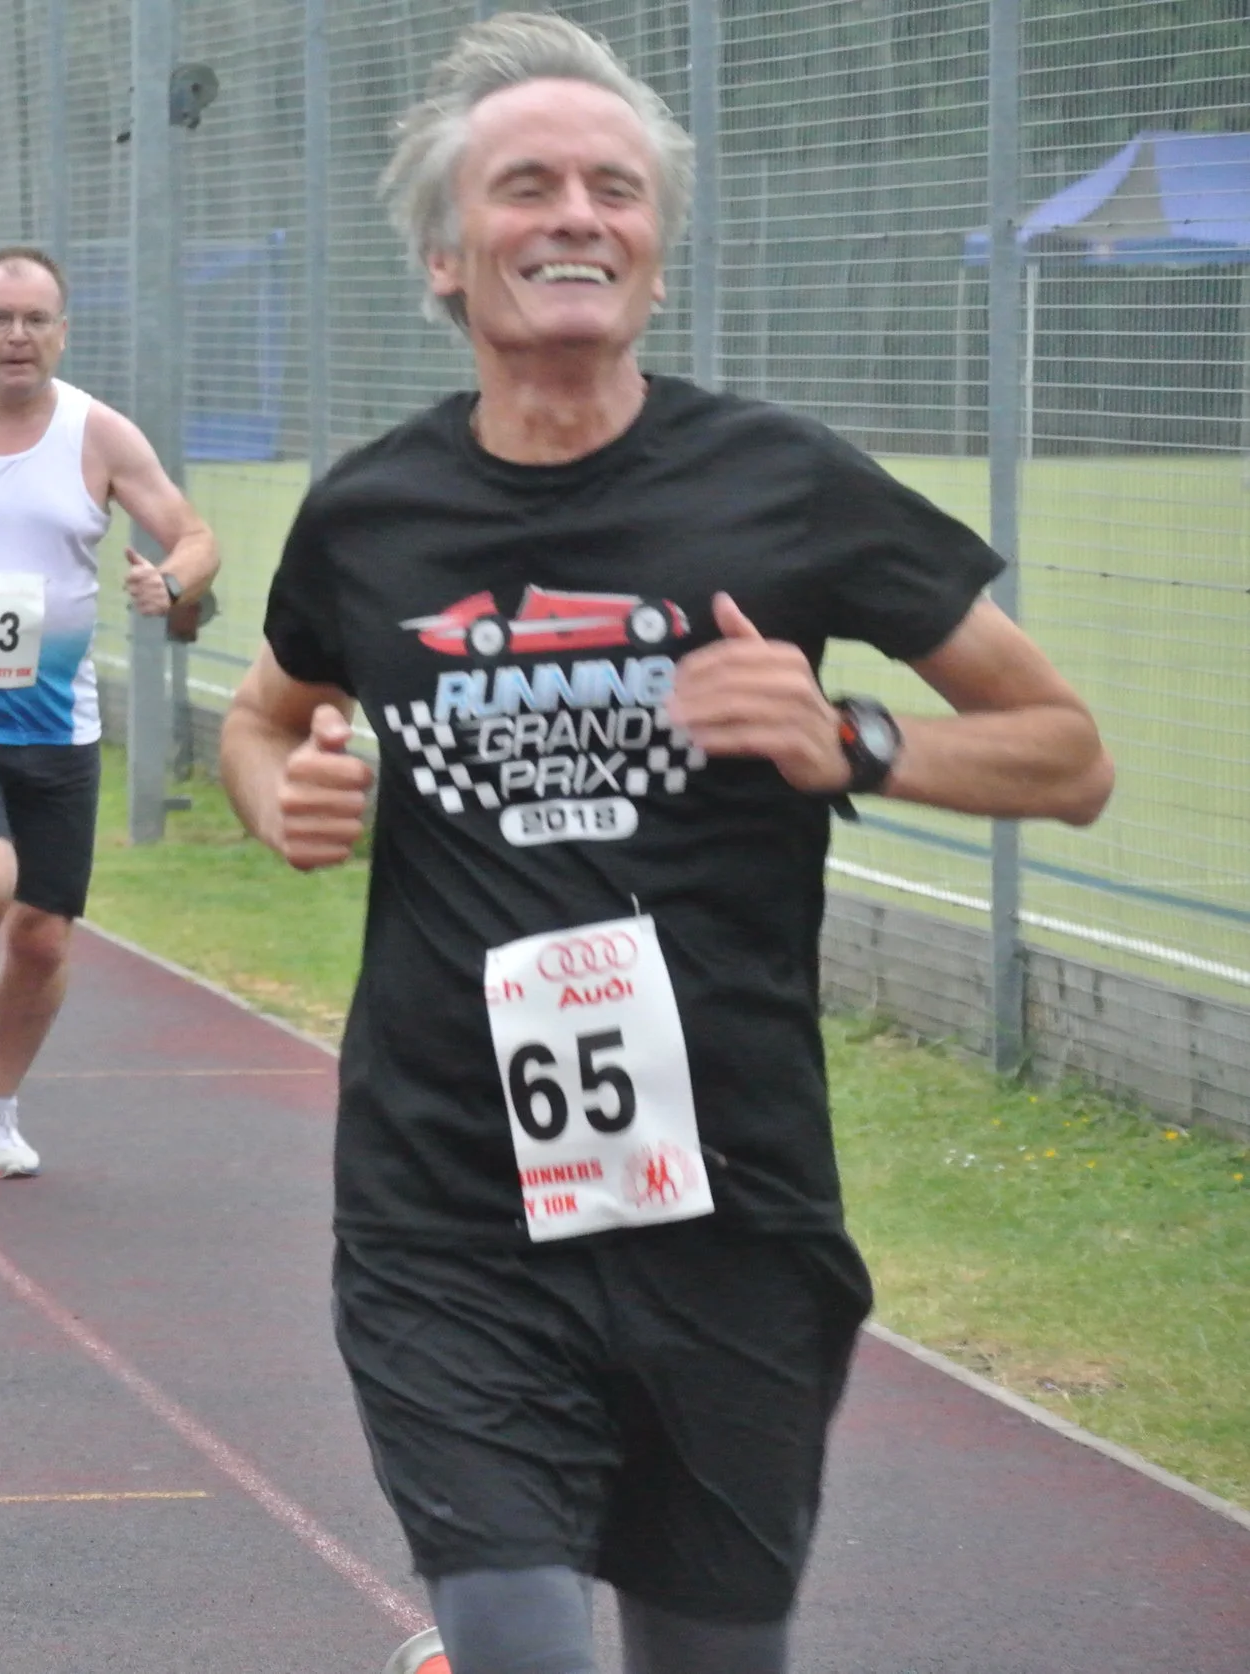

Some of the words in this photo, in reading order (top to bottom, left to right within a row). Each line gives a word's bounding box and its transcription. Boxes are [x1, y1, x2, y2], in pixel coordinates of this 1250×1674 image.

[434, 655, 677, 722] RUNNING
[479, 707, 652, 762] GRAND
[500, 751, 627, 799] PRIX
[521, 806, 616, 836] 2018
[509, 1026, 636, 1142] 65
